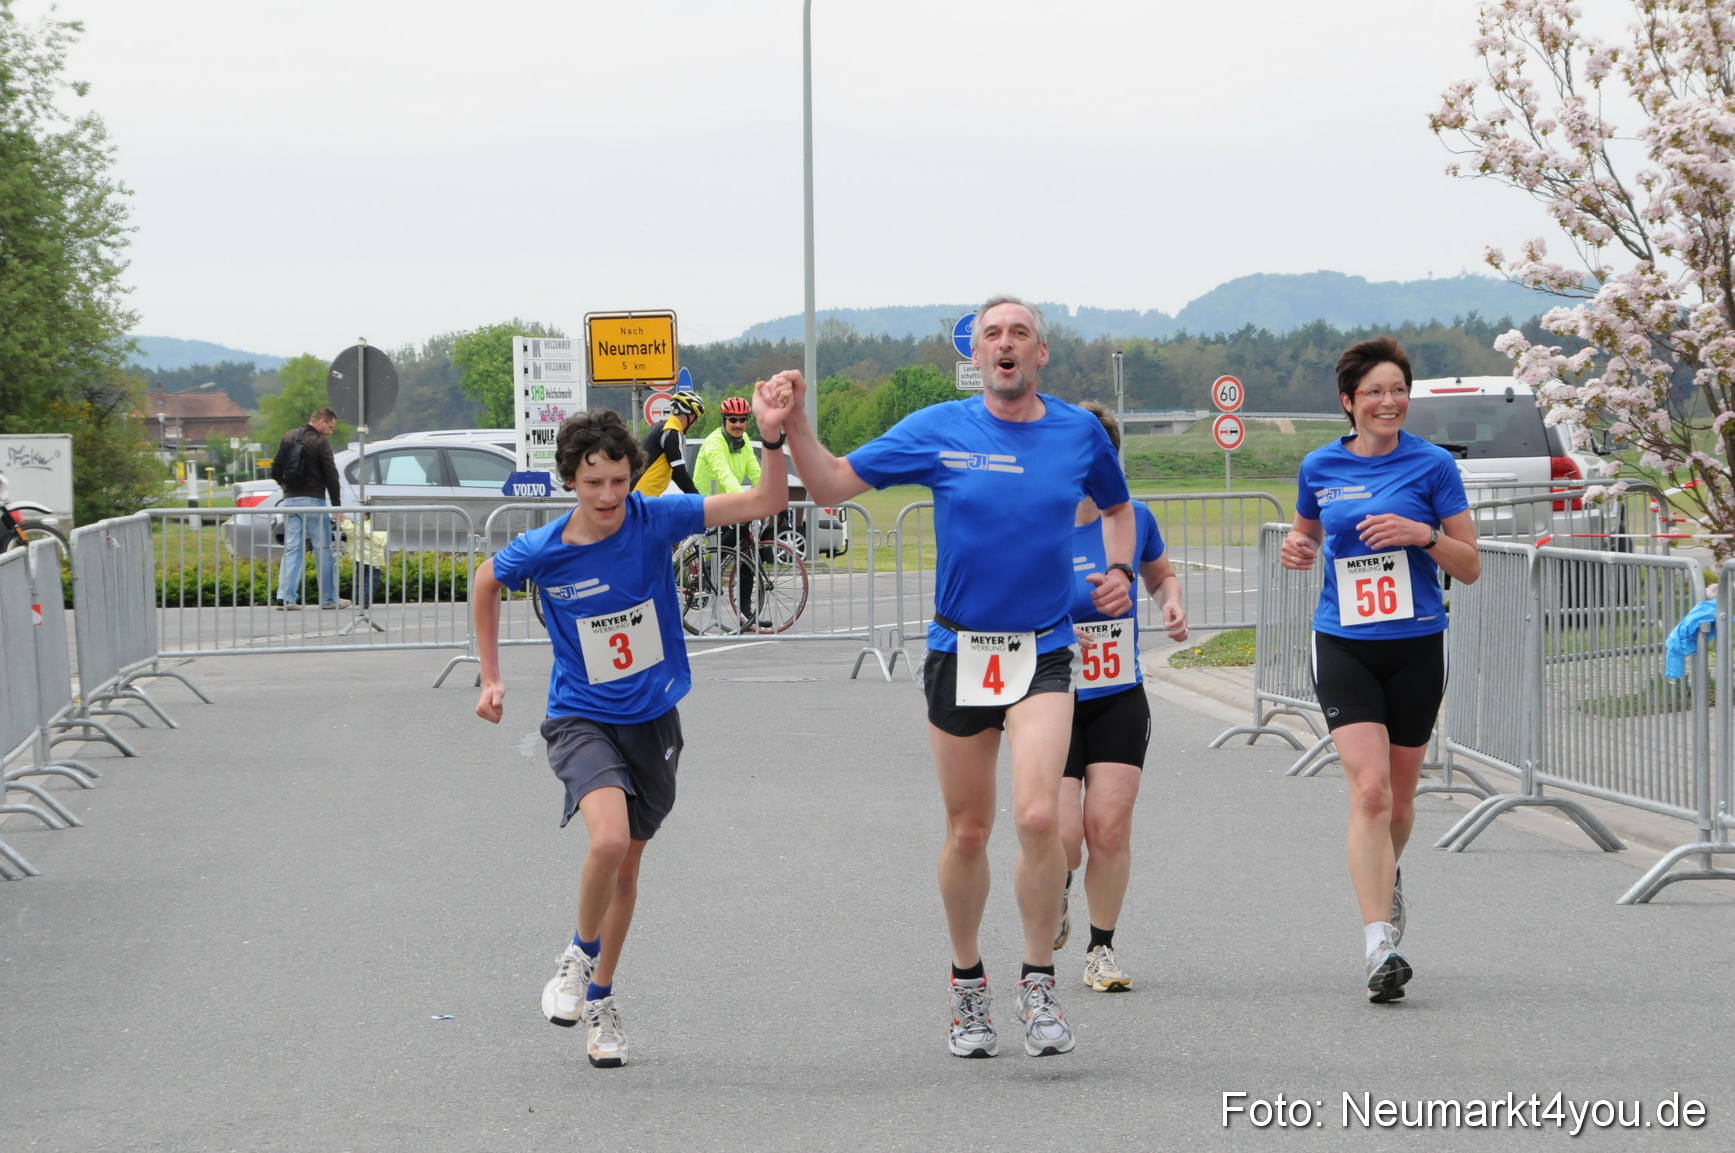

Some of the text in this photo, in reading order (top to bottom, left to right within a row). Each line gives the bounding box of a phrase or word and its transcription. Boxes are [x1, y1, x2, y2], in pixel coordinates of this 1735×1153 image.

[620, 327, 644, 335] Nach
[598, 339, 667, 356] Neumarkt
[622, 362, 646, 370] 5 km
[531, 385, 545, 401] SHB
[1220, 386, 1237, 401] 60
[532, 429, 555, 445] THULE
[532, 450, 557, 459] HEIDELBER
[513, 483, 546, 496] VOLVO
[1347, 557, 1380, 569] MEYER
[1348, 565, 1381, 574] WERBUNG
[1355, 576, 1398, 617] 56
[591, 614, 628, 629] MEYER
[592, 622, 629, 634] WERBUNG
[971, 635, 1005, 645] MEYER
[609, 632, 634, 670] 3
[971, 644, 1006, 652] WERBUNG
[1081, 641, 1121, 682] 55
[983, 654, 1005, 696] 4
